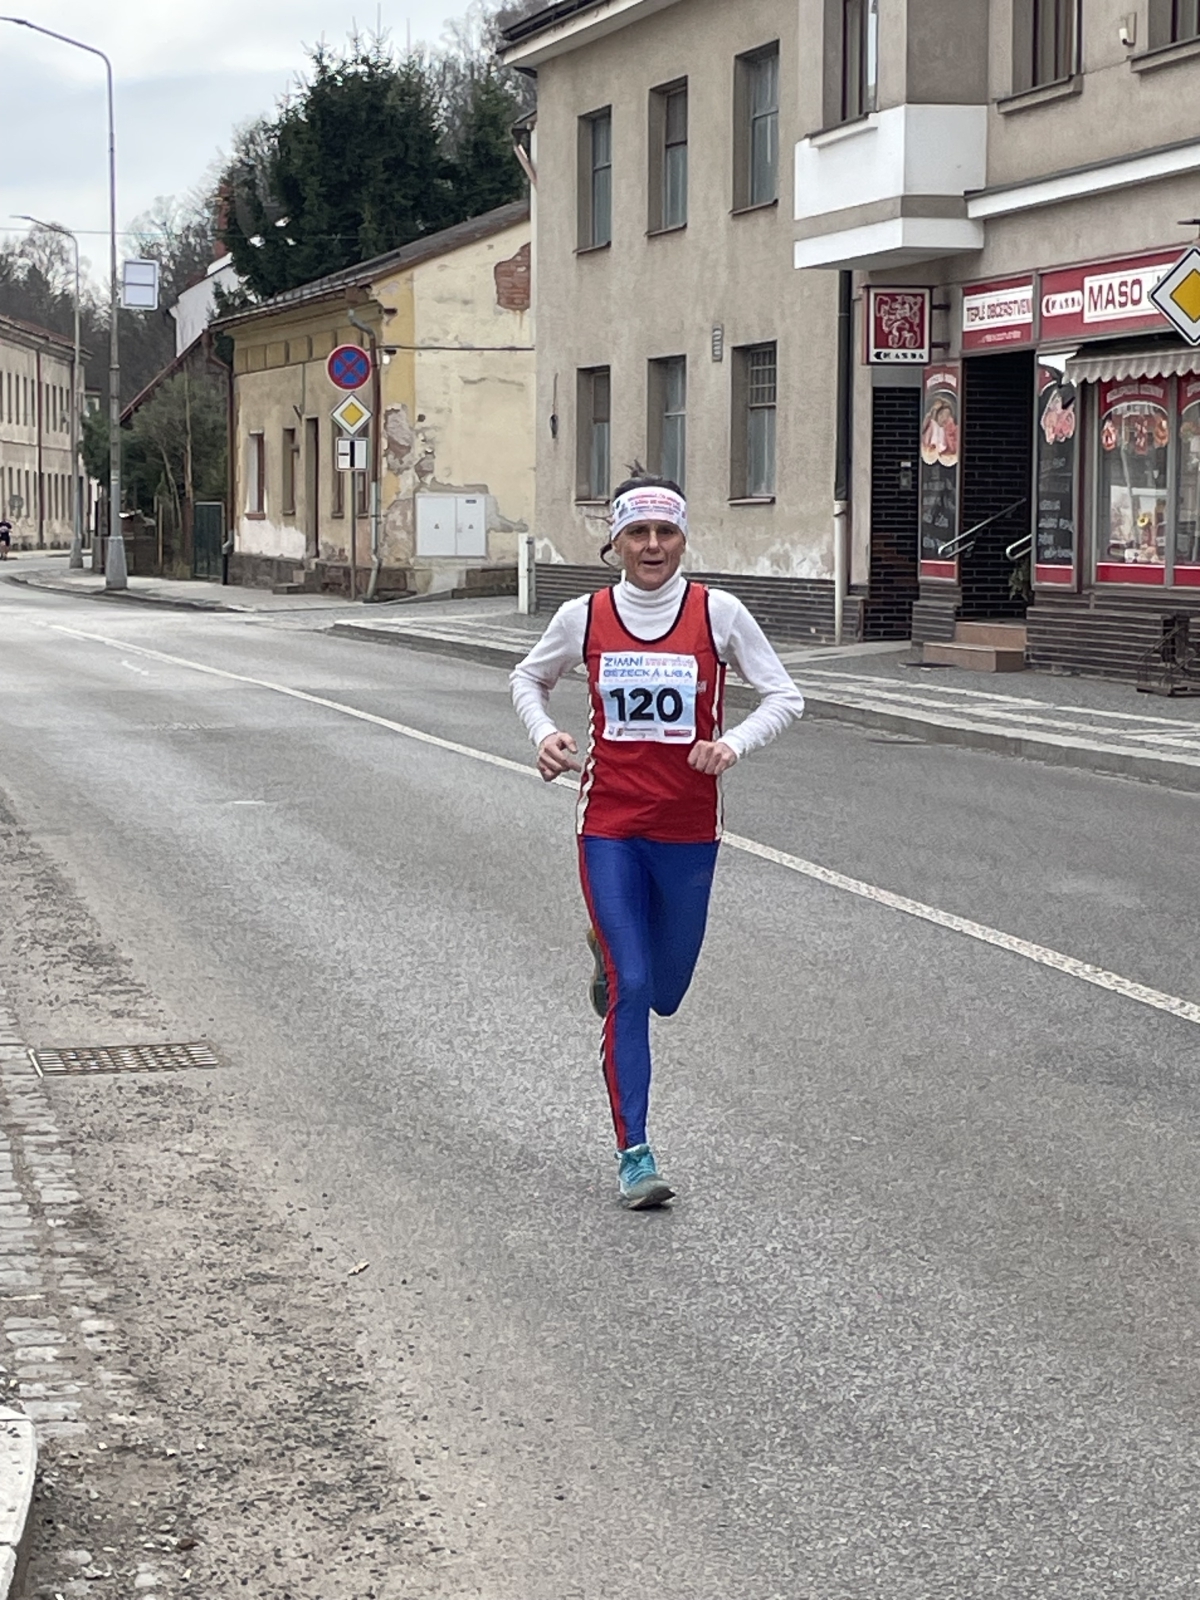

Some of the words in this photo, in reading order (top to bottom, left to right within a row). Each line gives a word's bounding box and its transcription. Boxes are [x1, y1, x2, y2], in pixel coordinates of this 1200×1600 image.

[1088, 278, 1143, 313] MASO
[604, 656, 644, 667] ZIMNÍ
[664, 669, 693, 679] LIGA
[609, 687, 684, 722] 120
